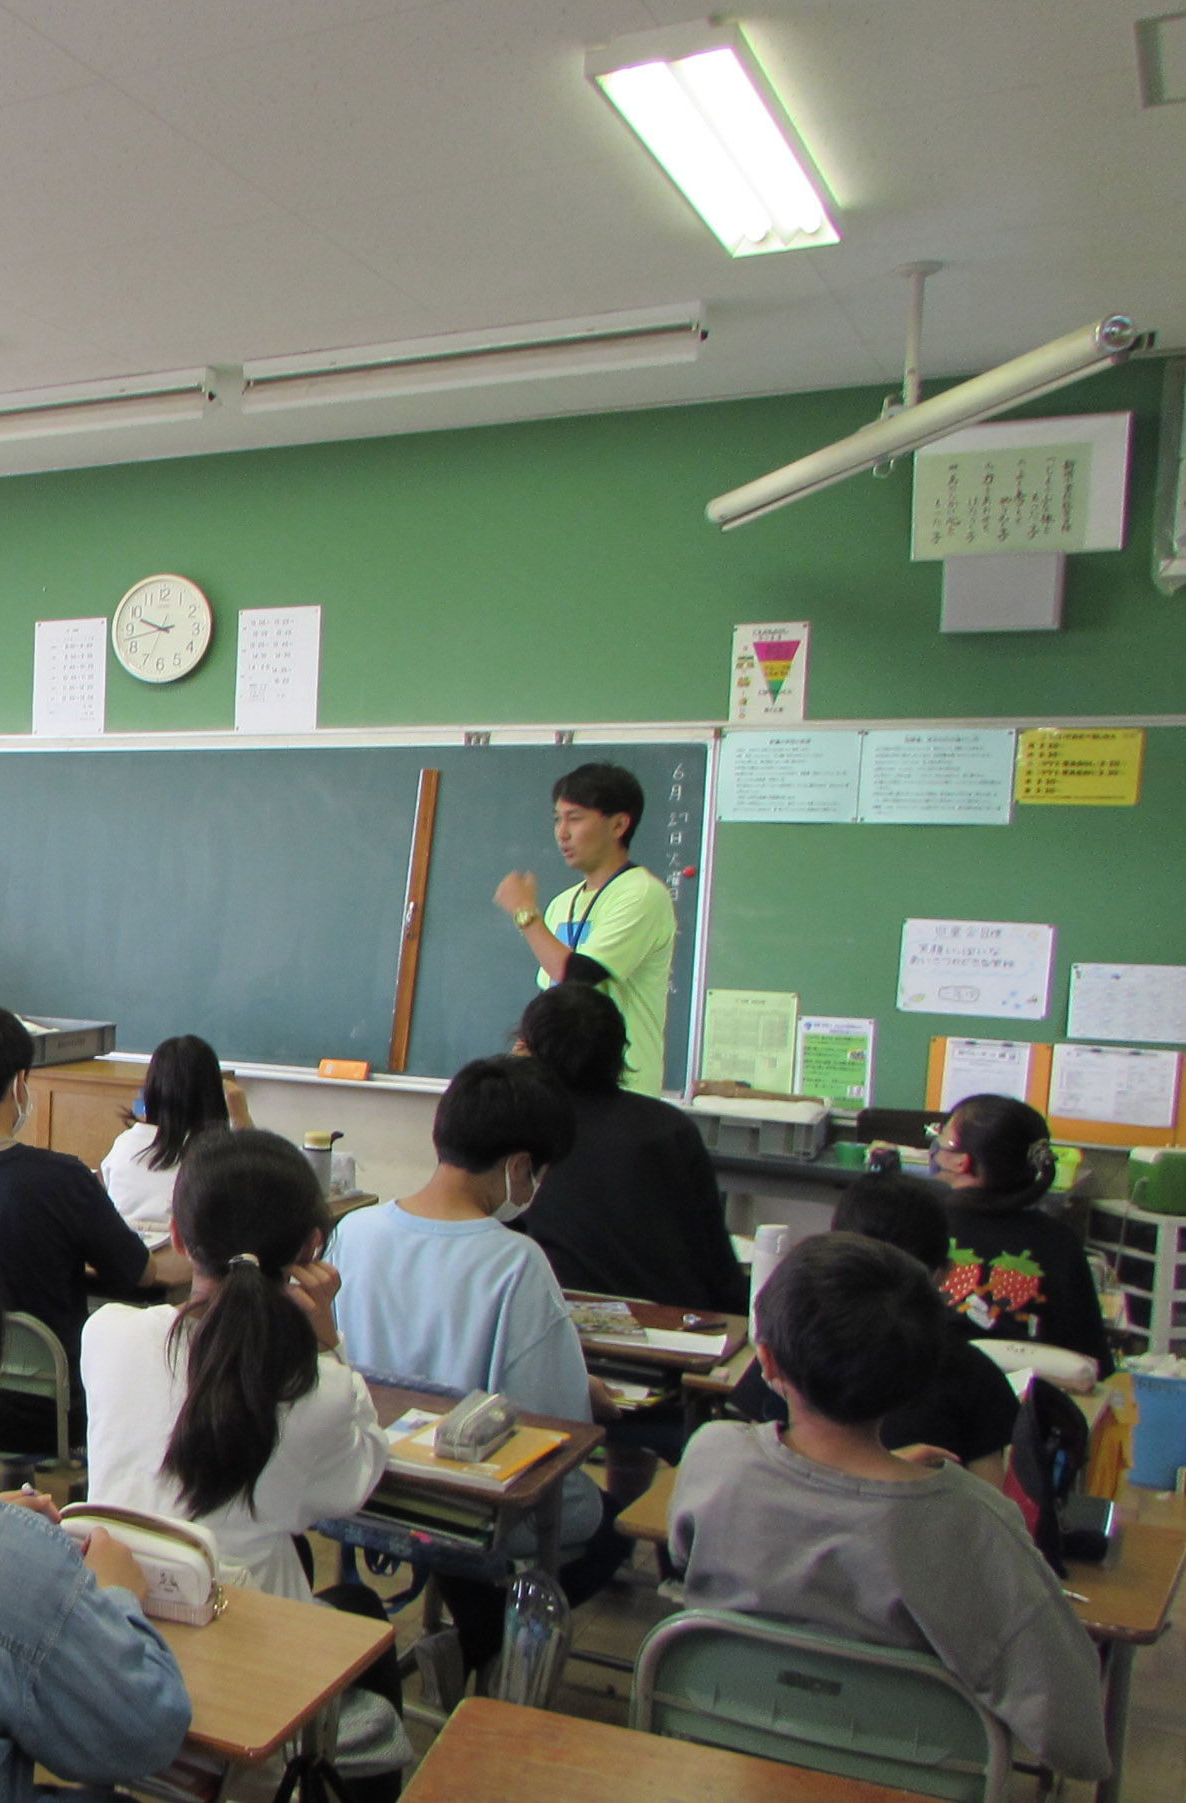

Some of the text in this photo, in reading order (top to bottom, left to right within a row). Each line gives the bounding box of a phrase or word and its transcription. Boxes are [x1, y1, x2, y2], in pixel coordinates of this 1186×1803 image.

[144, 593, 154, 606] 11
[159, 588, 171, 601] 12
[178, 592, 183, 606] 1
[131, 605, 143, 619] 10
[188, 604, 197, 618] 2
[126, 622, 135, 636] 9
[191, 622, 201, 636] 3
[129, 641, 138, 654] 8
[186, 641, 194, 653] 4
[142, 653, 151, 666] 7
[156, 658, 165, 671] 6
[173, 653, 182, 666] 5
